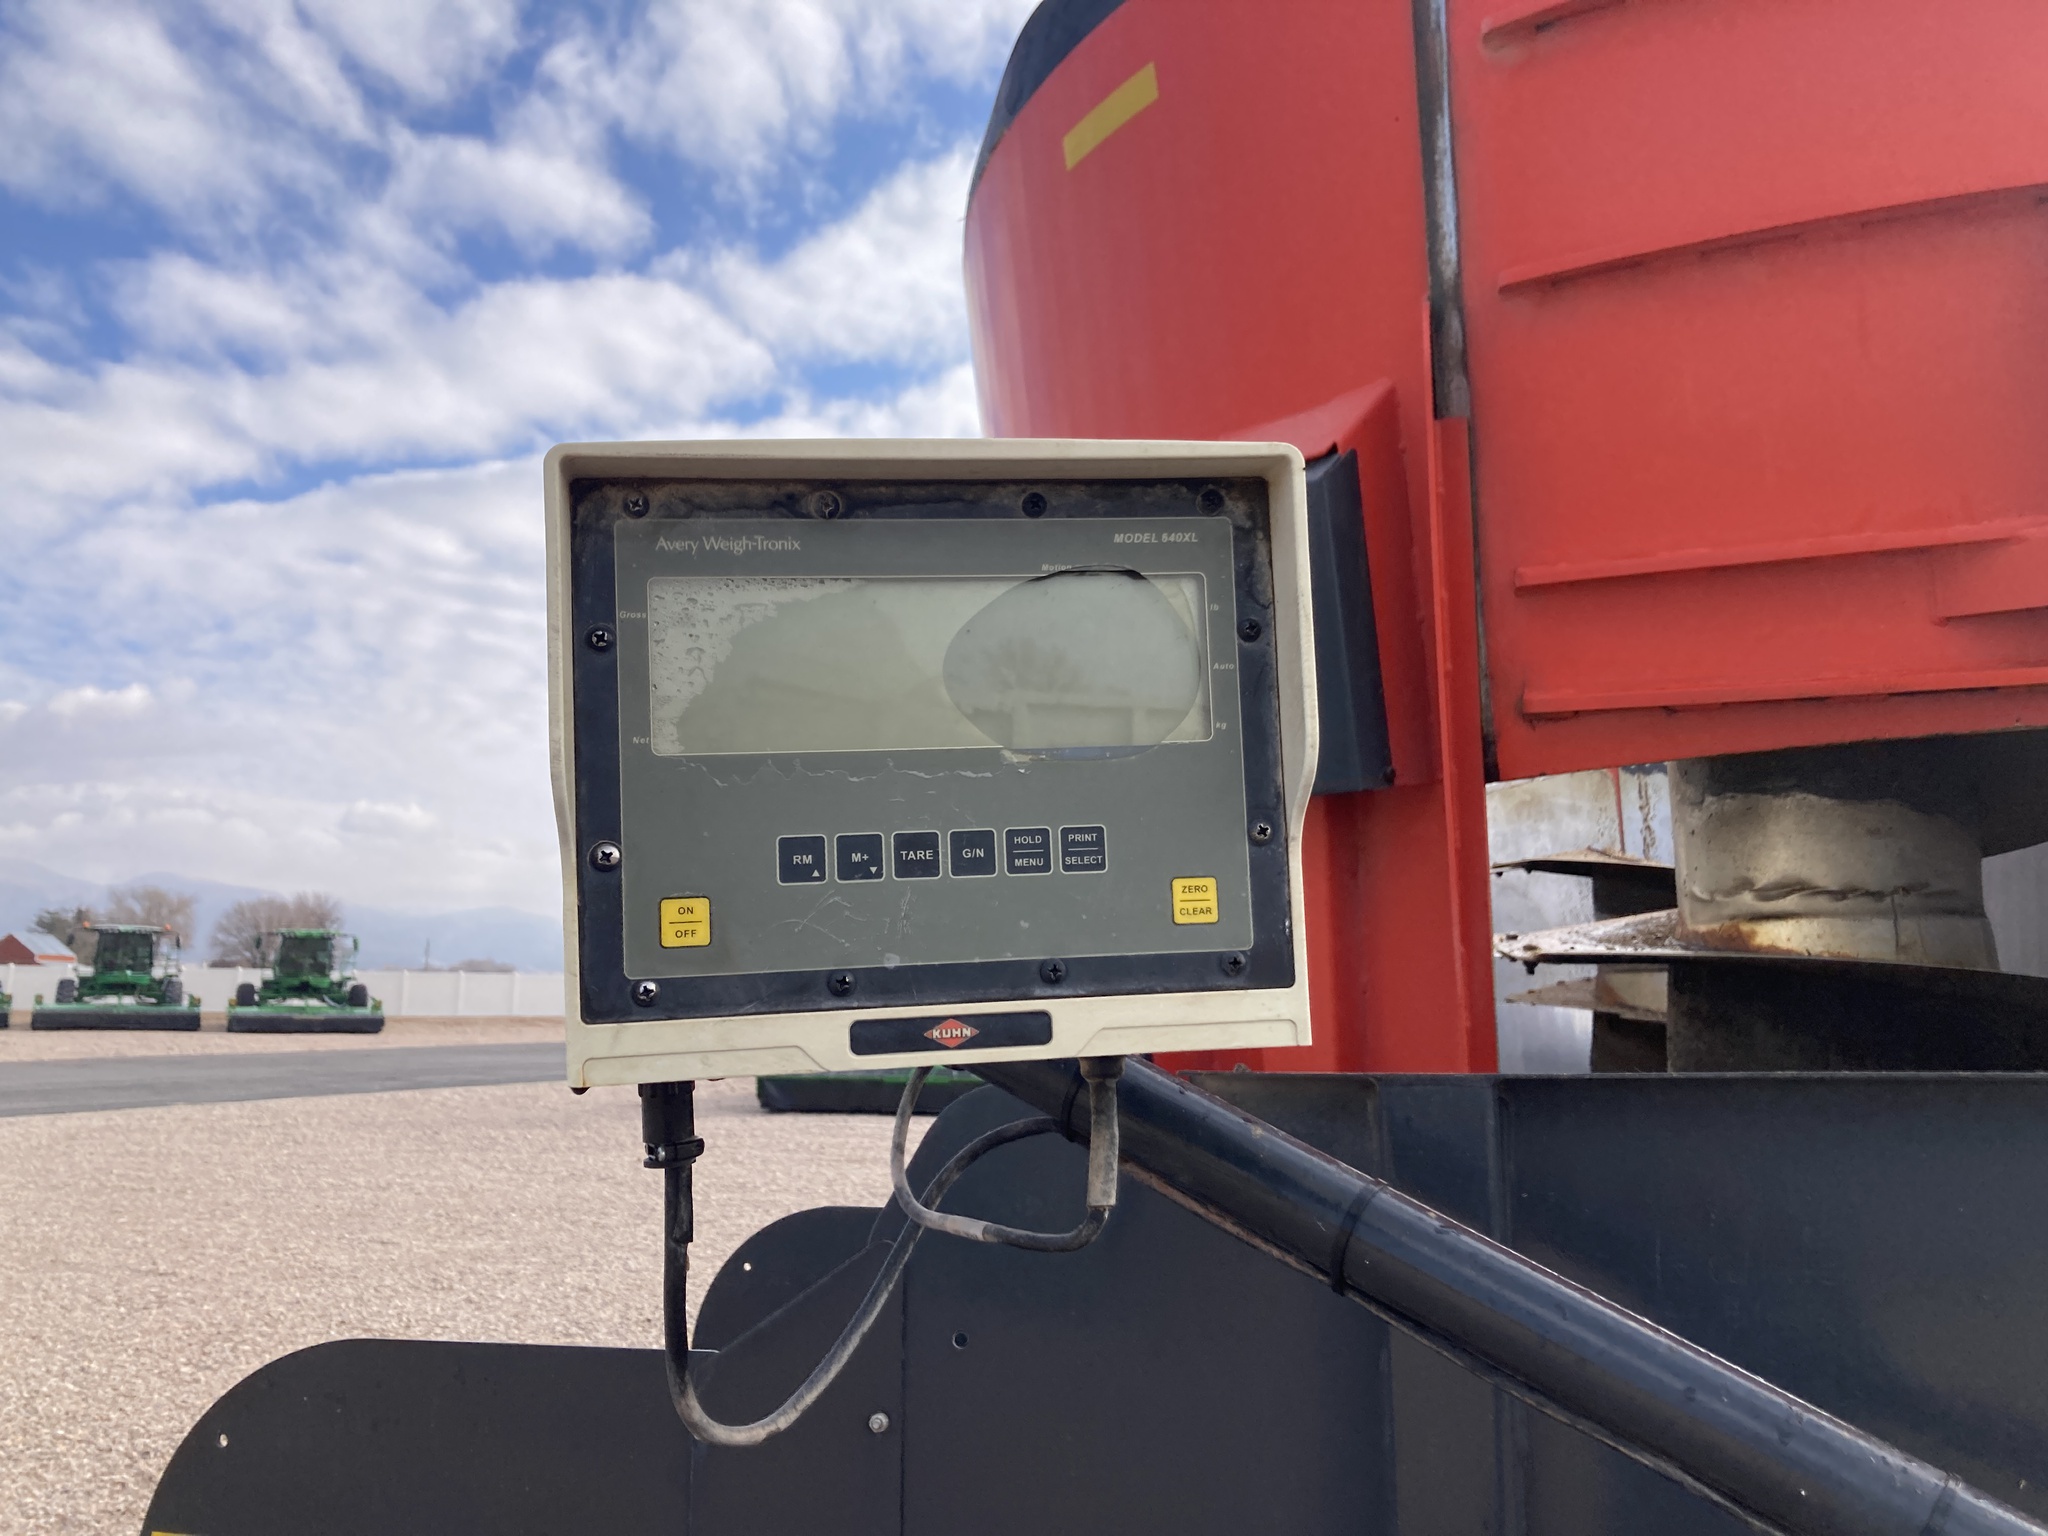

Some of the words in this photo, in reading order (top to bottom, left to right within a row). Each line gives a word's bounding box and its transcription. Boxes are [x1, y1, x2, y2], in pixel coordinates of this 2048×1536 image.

[1113, 533, 1159, 544] MODEL
[655, 536, 699, 555] Avery
[702, 535, 801, 555] Weigh-Tronix
[619, 610, 647, 619] Gross
[1212, 662, 1235, 670] Auto
[1215, 721, 1227, 730] kg
[1013, 835, 1042, 845] HOLD
[1068, 833, 1097, 843] PRINT
[851, 852, 869, 863] M+
[900, 850, 934, 861] TARE
[962, 848, 985, 859] G/N
[792, 854, 813, 865] RM
[1014, 858, 1044, 867] MENU
[1064, 855, 1103, 866] SELECT
[1181, 884, 1208, 894] ZERO
[677, 906, 694, 915] ON
[1179, 906, 1212, 916] CLEAR
[675, 929, 697, 939] OFF
[932, 1027, 972, 1039] KUHN
